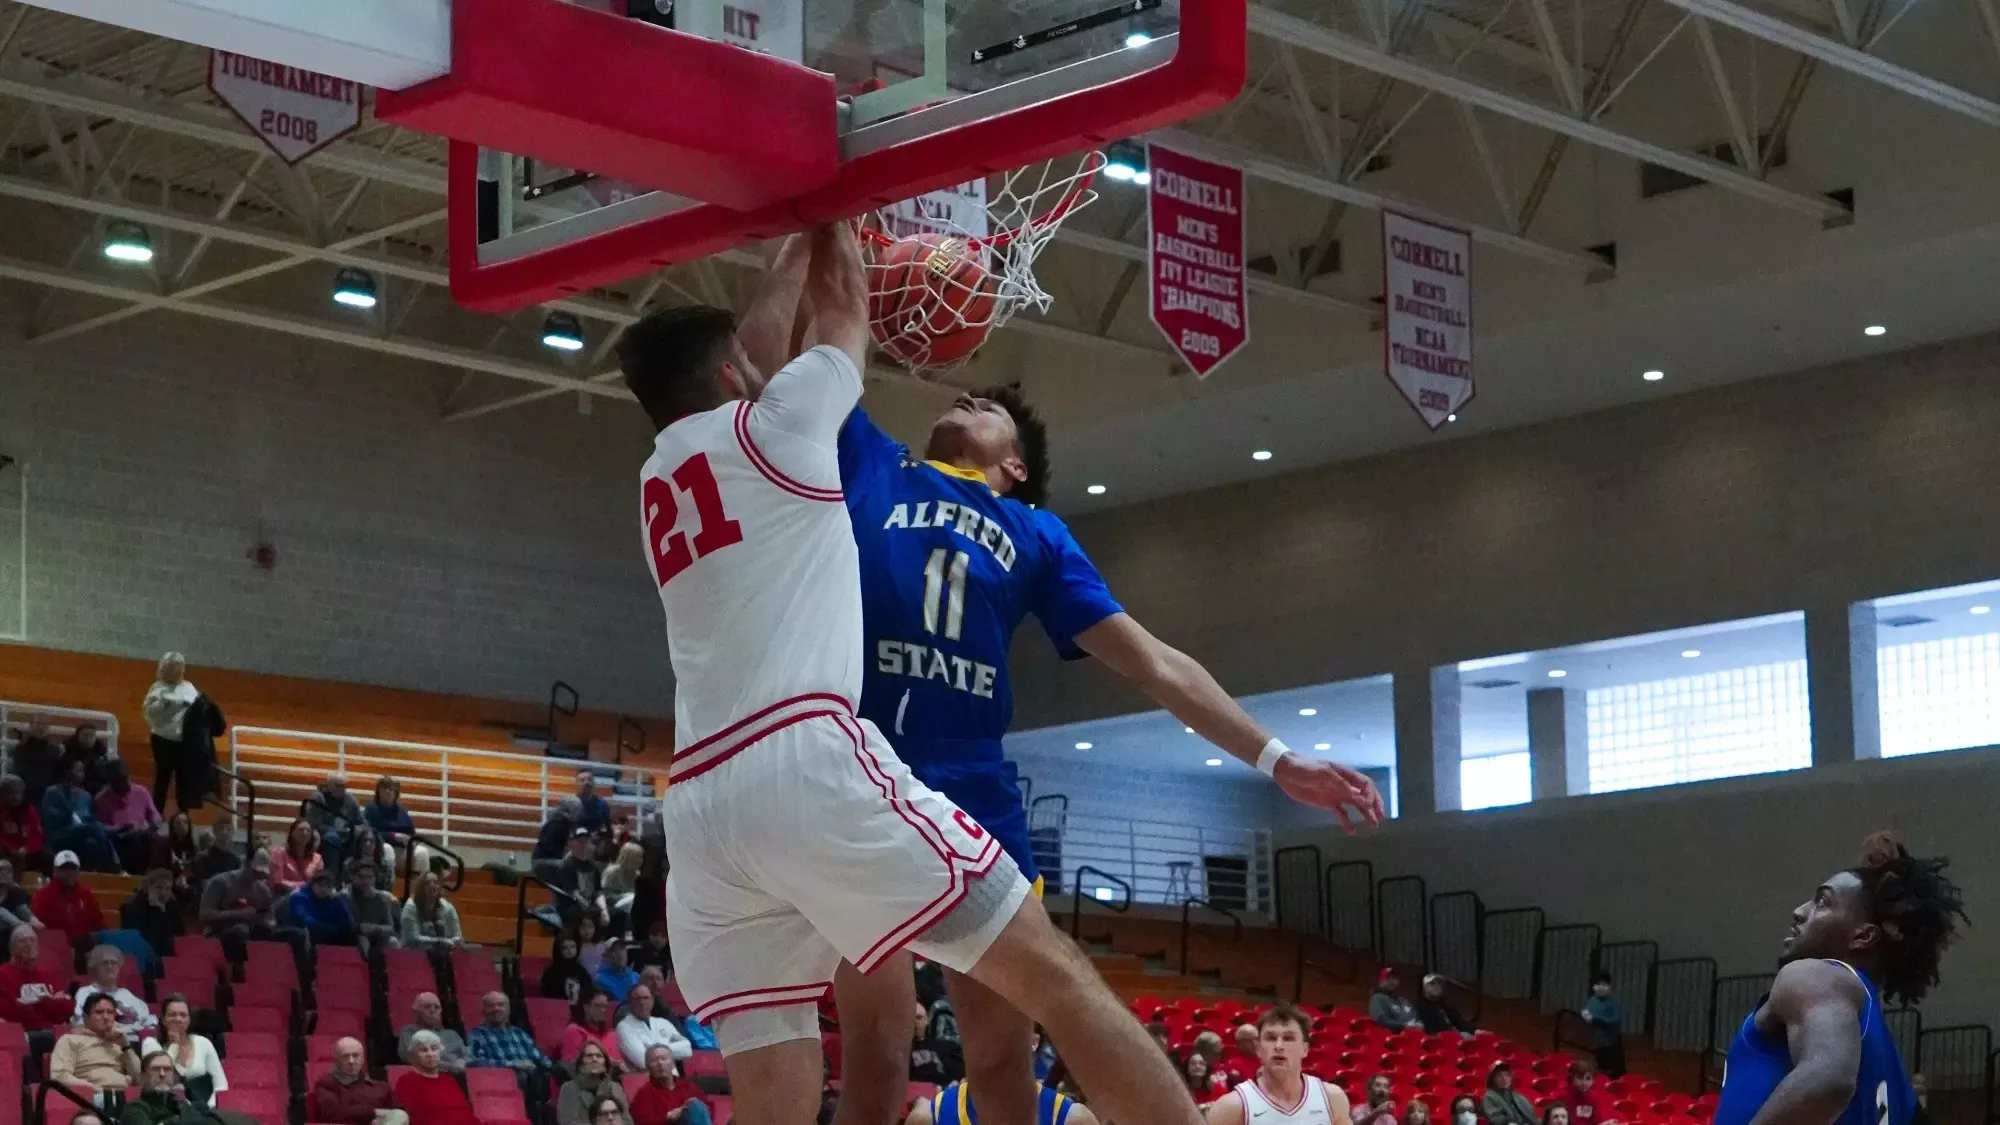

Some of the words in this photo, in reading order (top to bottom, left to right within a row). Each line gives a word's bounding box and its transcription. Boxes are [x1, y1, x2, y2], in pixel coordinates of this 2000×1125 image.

[218, 50, 354, 105] TOURNAMENT
[260, 109, 318, 144] 2008
[1155, 168, 1238, 216] CORNELL
[1177, 215, 1219, 243] MEN'S
[1157, 232, 1241, 273] BASKETBALL
[1391, 235, 1465, 276] CORNELL
[1160, 259, 1182, 284] IVY
[1186, 267, 1239, 297] LEAGUE
[1160, 285, 1240, 329] CHAMPIONS
[1394, 293, 1466, 328] BASKETBALL
[1181, 328, 1220, 357] 2009
[1415, 326, 1448, 353] NCAA
[1392, 343, 1469, 381] TOURNAMENT
[642, 451, 744, 588] 21
[882, 500, 1017, 573] ALFRED
[923, 547, 970, 641] 11
[877, 639, 997, 699] STATE
[952, 808, 985, 841] C
